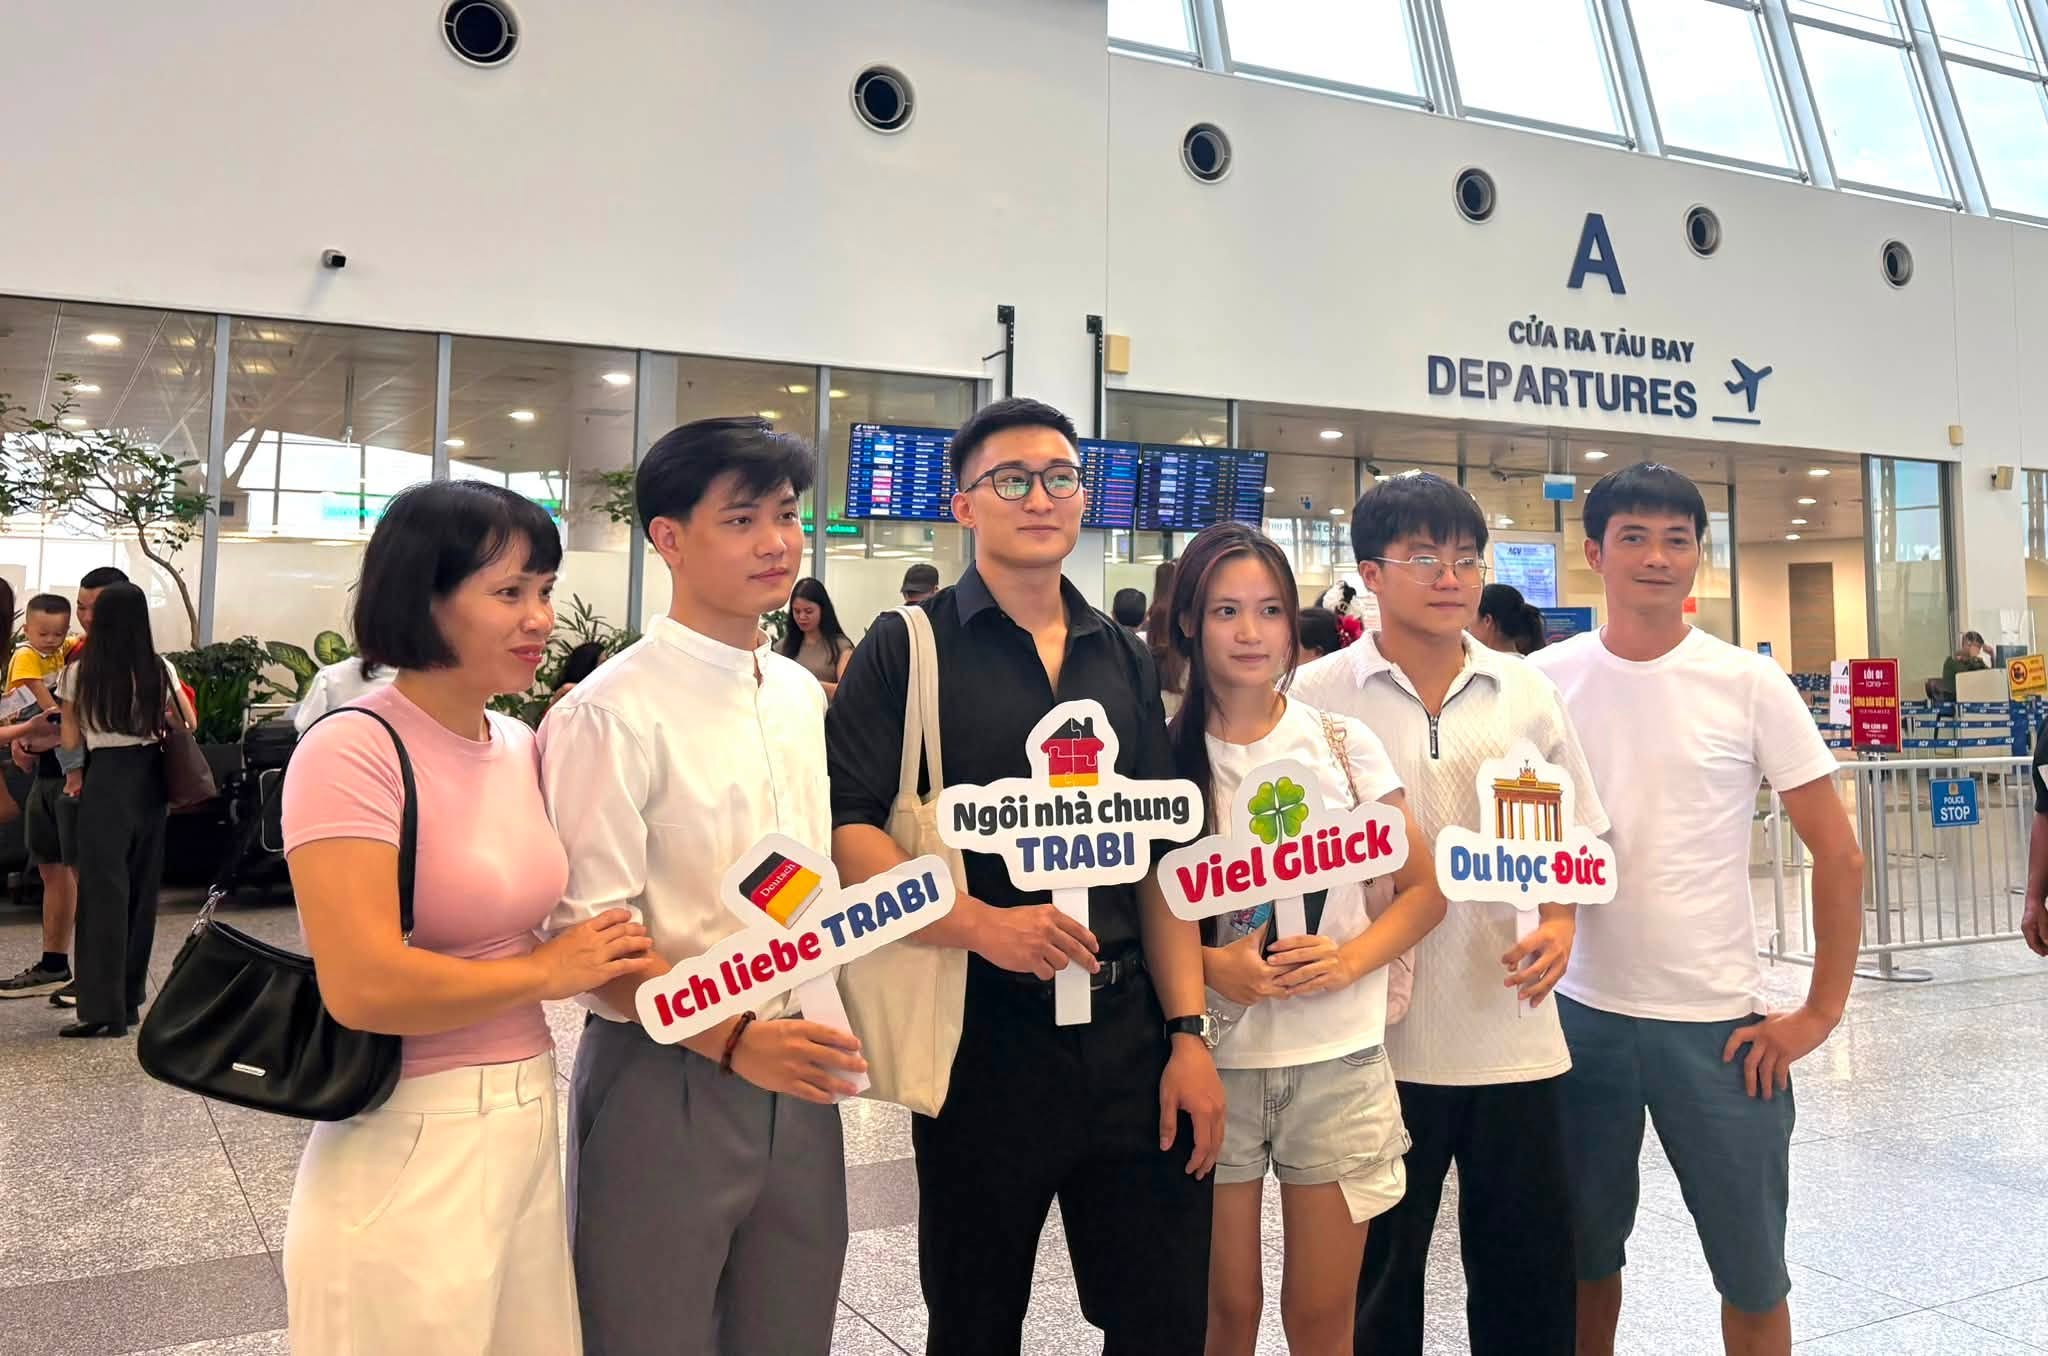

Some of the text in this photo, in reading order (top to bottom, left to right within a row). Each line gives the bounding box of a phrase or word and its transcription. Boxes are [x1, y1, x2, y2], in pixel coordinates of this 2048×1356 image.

[1567, 213, 1626, 294] A
[1508, 314, 1694, 363] CỬA RA TÀU BAY
[1427, 354, 1698, 419] DEPARTURES
[954, 794, 1190, 835] Ngôi nhà chung
[1940, 806, 1970, 821] STOP
[1943, 796, 1965, 805] POLICE
[1016, 831, 1135, 873] TRABI
[1175, 819, 1394, 904] Viel Glück
[1450, 845, 1606, 893] Du học Đức
[760, 863, 796, 897] Deutsch
[653, 871, 940, 1027] Ich liebe TRABI
